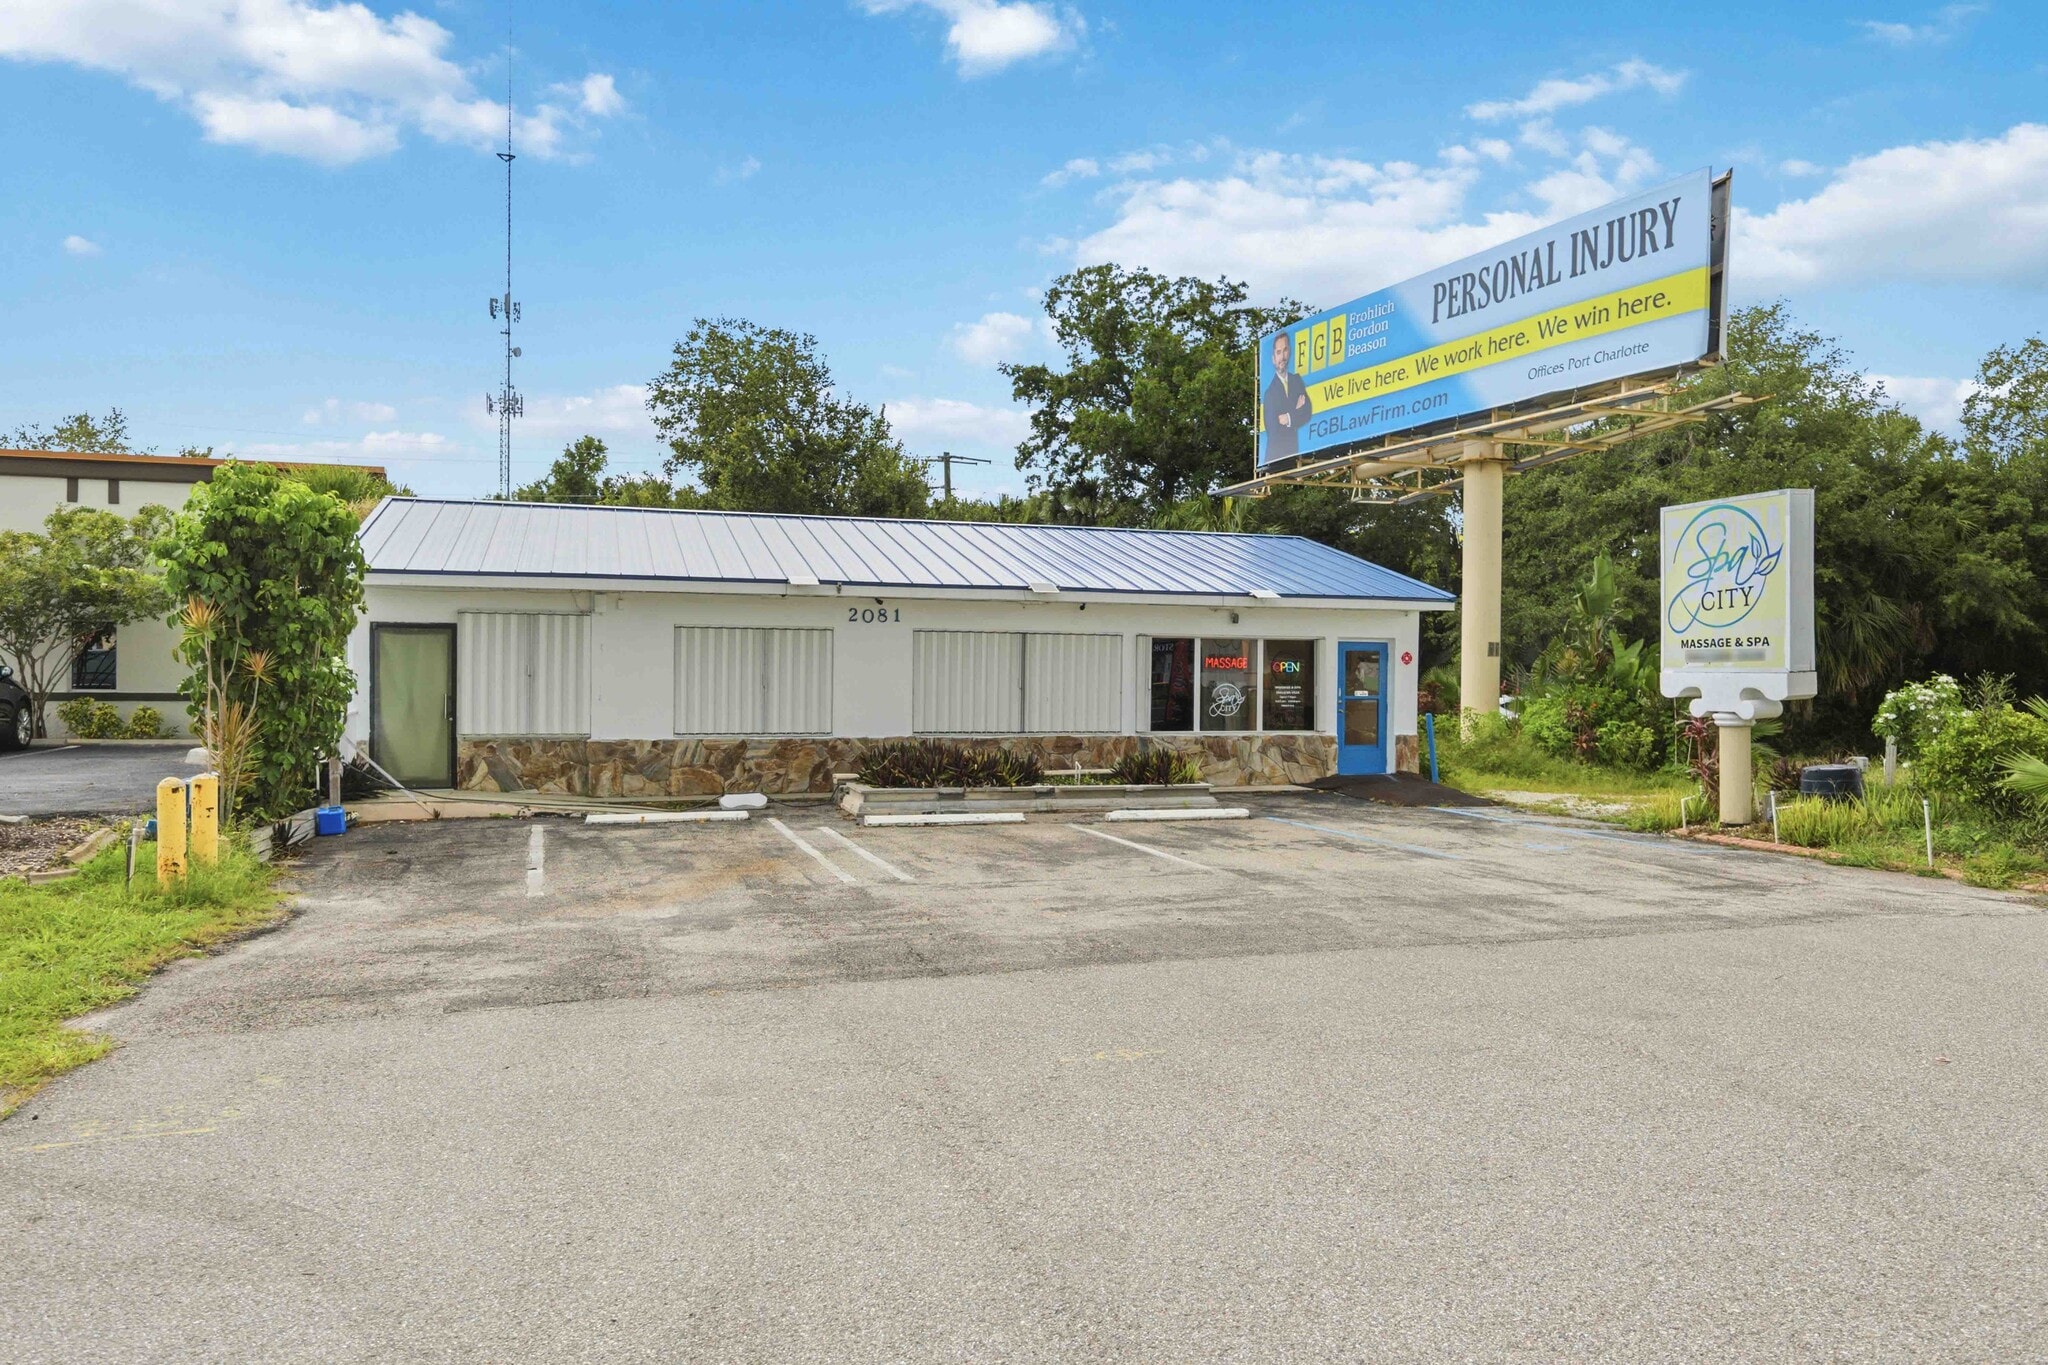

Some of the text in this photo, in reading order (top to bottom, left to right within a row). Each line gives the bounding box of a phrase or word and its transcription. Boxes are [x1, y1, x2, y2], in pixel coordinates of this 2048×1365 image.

[1431, 197, 1681, 324] PERSONAL INJURY
[1349, 300, 1395, 326] Frohlich
[1348, 319, 1389, 341] Gordon
[1323, 292, 1671, 402] We live here. We work here. We win here.
[1347, 336, 1387, 358] Beason
[1527, 342, 1649, 380] Offices Port Charlotte
[1308, 392, 1448, 440] FGBLawFirm.com
[1701, 586, 1754, 611] CITY
[849, 608, 900, 623] 2081
[1681, 637, 1770, 649] MASSAGE & SPA
[1205, 657, 1248, 669] MASSAGE
[1273, 661, 1300, 672] OPEN
